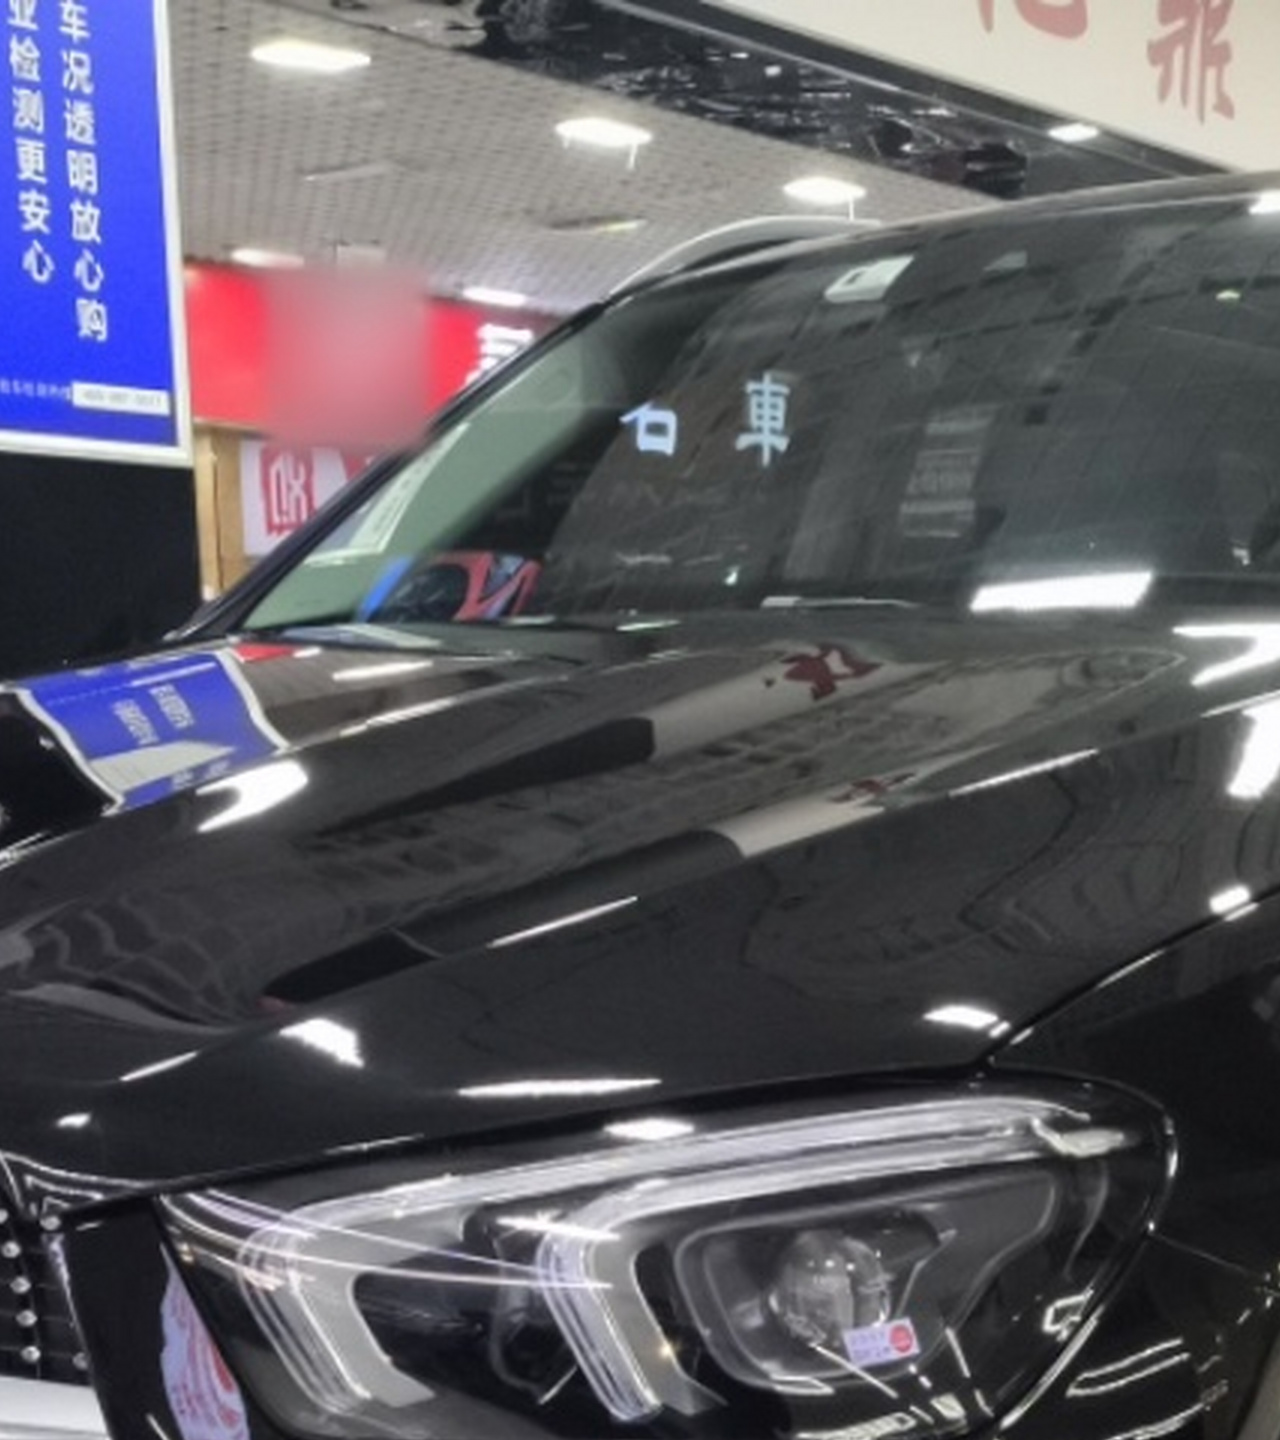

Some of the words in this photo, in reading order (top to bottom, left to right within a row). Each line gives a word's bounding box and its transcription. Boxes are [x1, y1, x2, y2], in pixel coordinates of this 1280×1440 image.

[58, 0, 108, 343] 车况透明放心购
